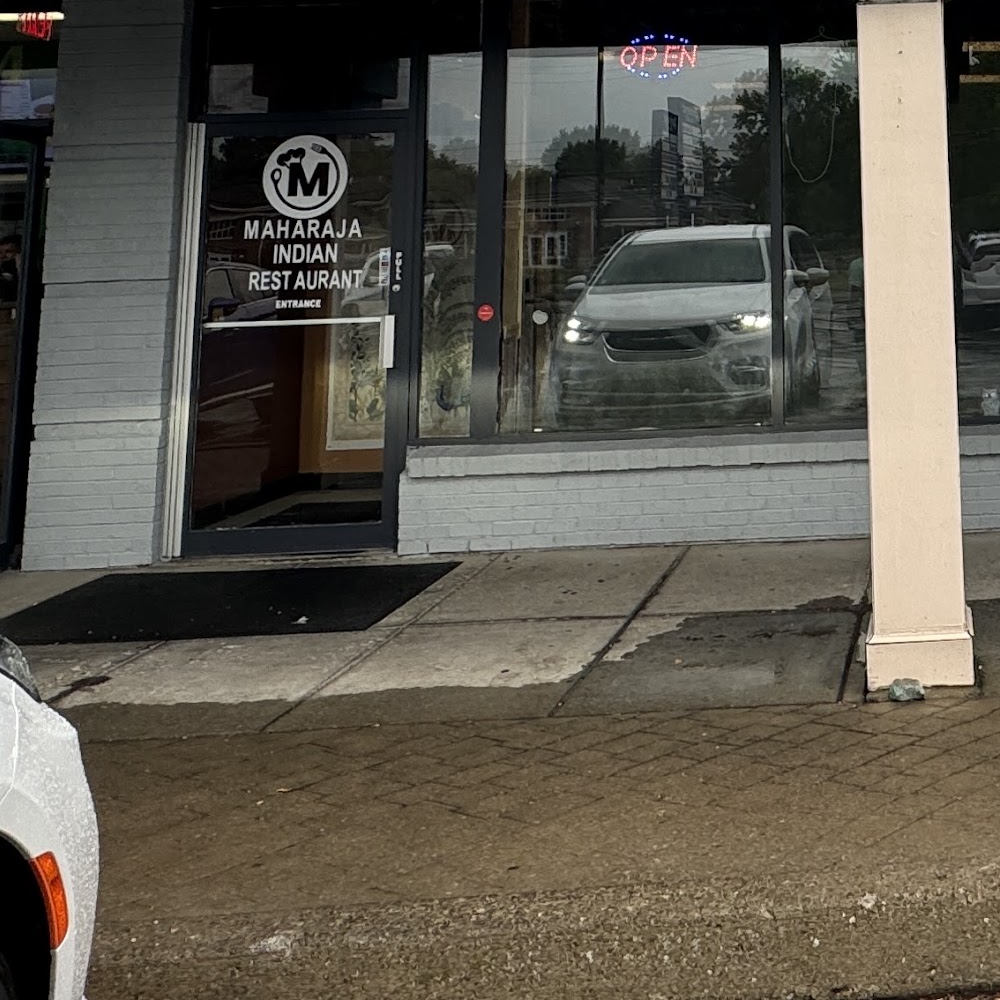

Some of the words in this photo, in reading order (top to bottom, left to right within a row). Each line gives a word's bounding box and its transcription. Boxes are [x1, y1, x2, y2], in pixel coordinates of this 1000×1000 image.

[619, 44, 698, 69] OPEN
[287, 161, 330, 197] M
[243, 218, 363, 240] MAHARAJA
[273, 243, 338, 265] INDIAN
[395, 251, 403, 281] PULL
[248, 269, 363, 291] RESTAURANT
[275, 299, 322, 310] ENTRANCE
